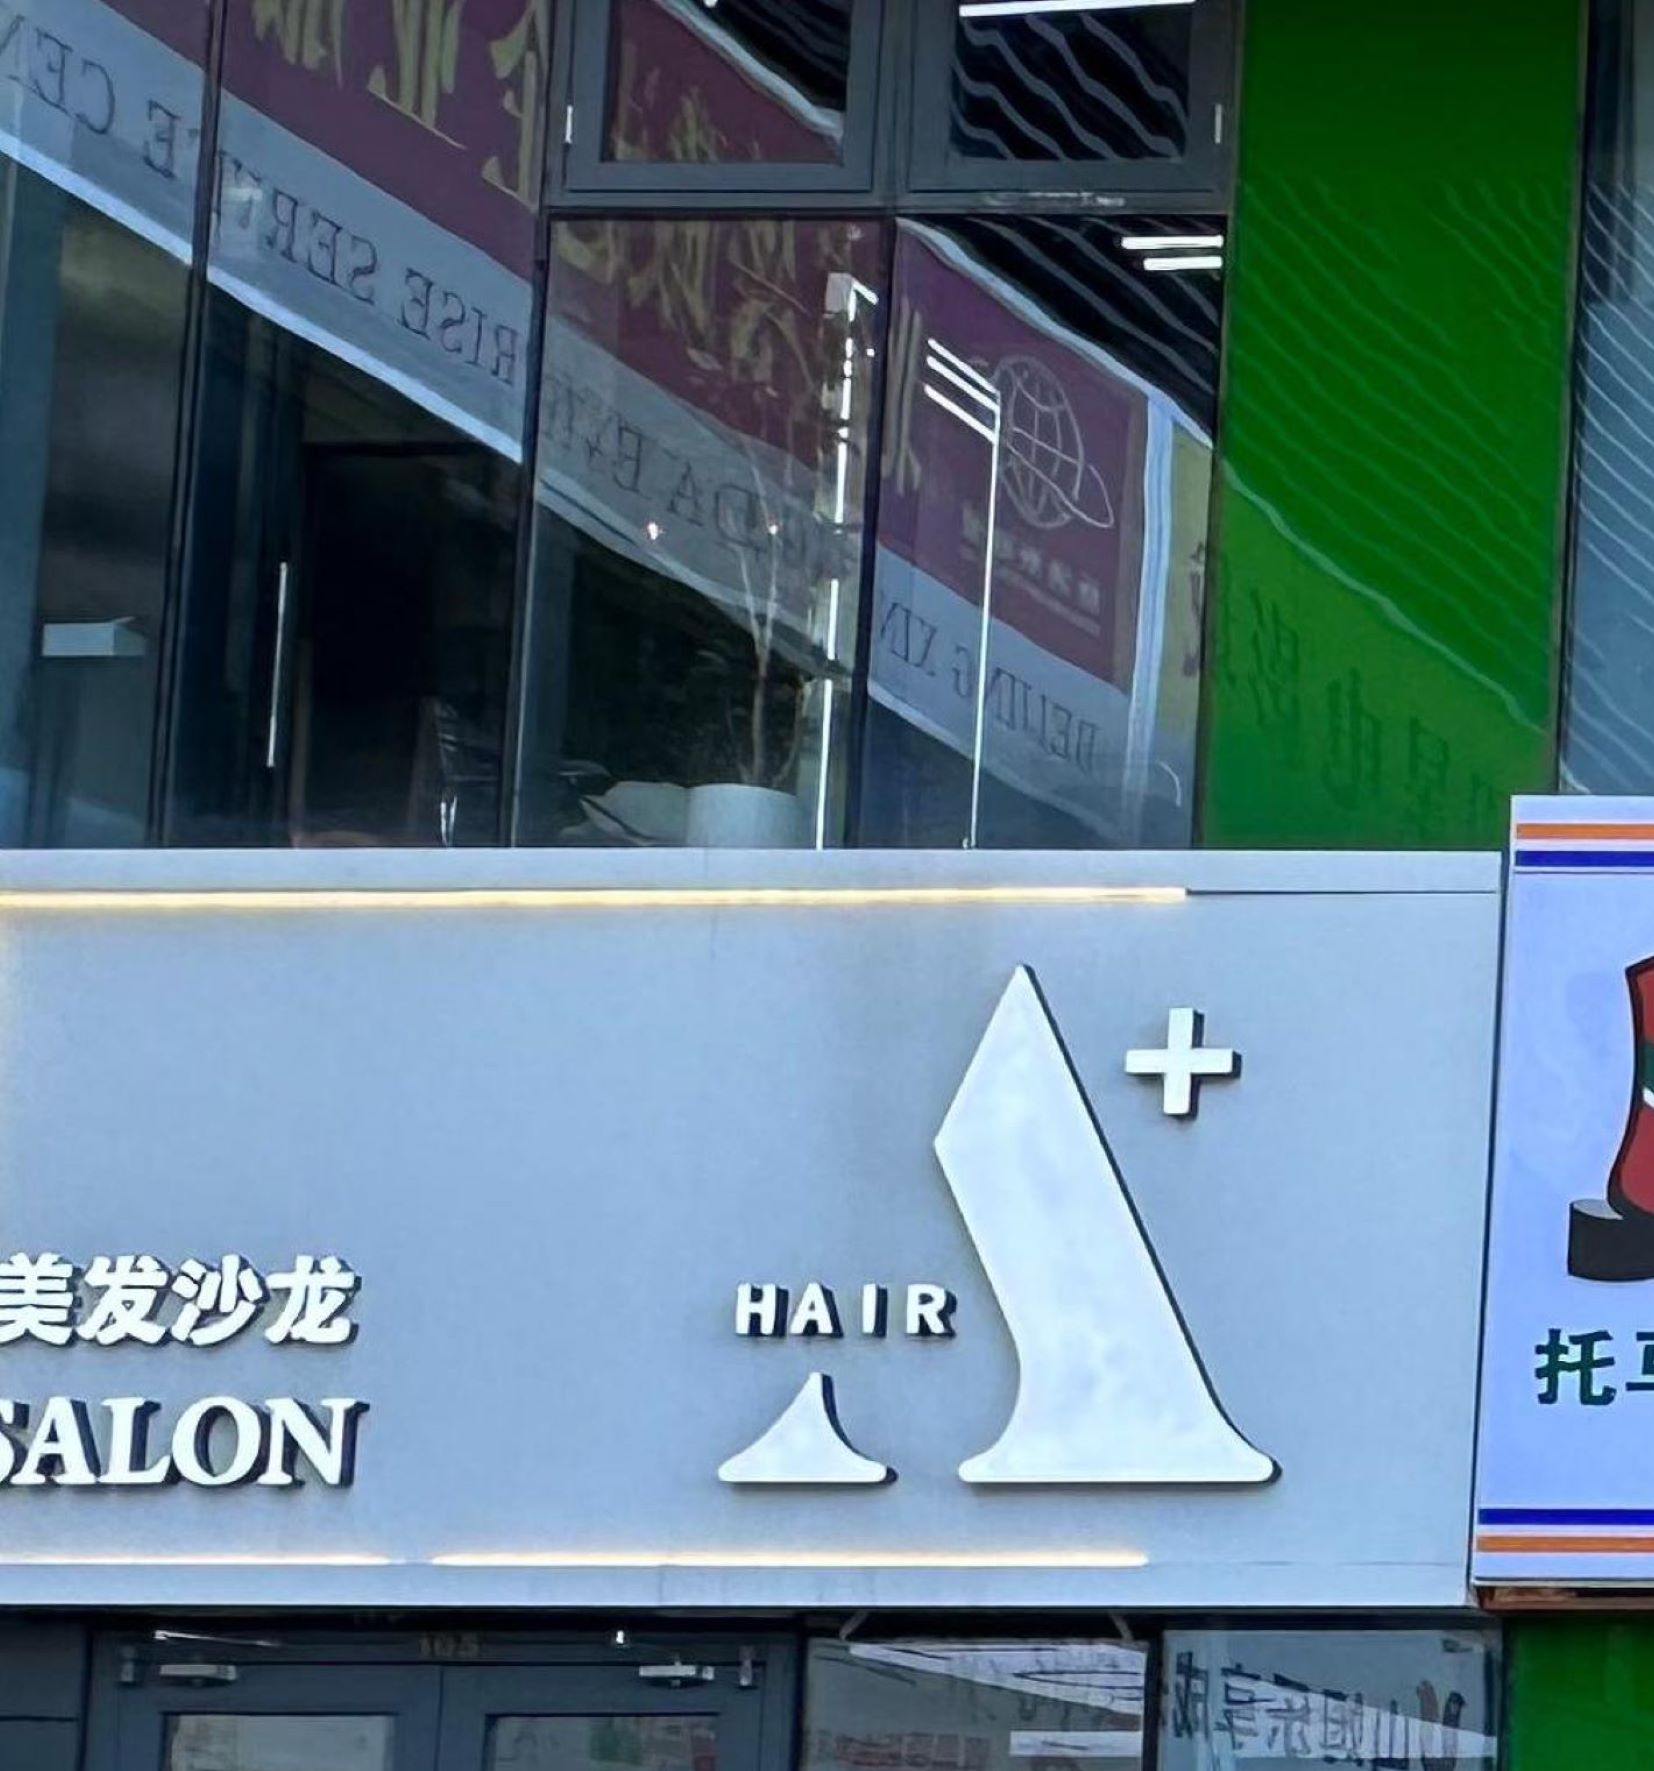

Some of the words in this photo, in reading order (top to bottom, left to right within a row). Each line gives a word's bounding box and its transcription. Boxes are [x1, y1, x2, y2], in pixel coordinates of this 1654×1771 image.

[0, 1252, 361, 1345] 美发沙龙
[735, 1282, 954, 1338] HAIR
